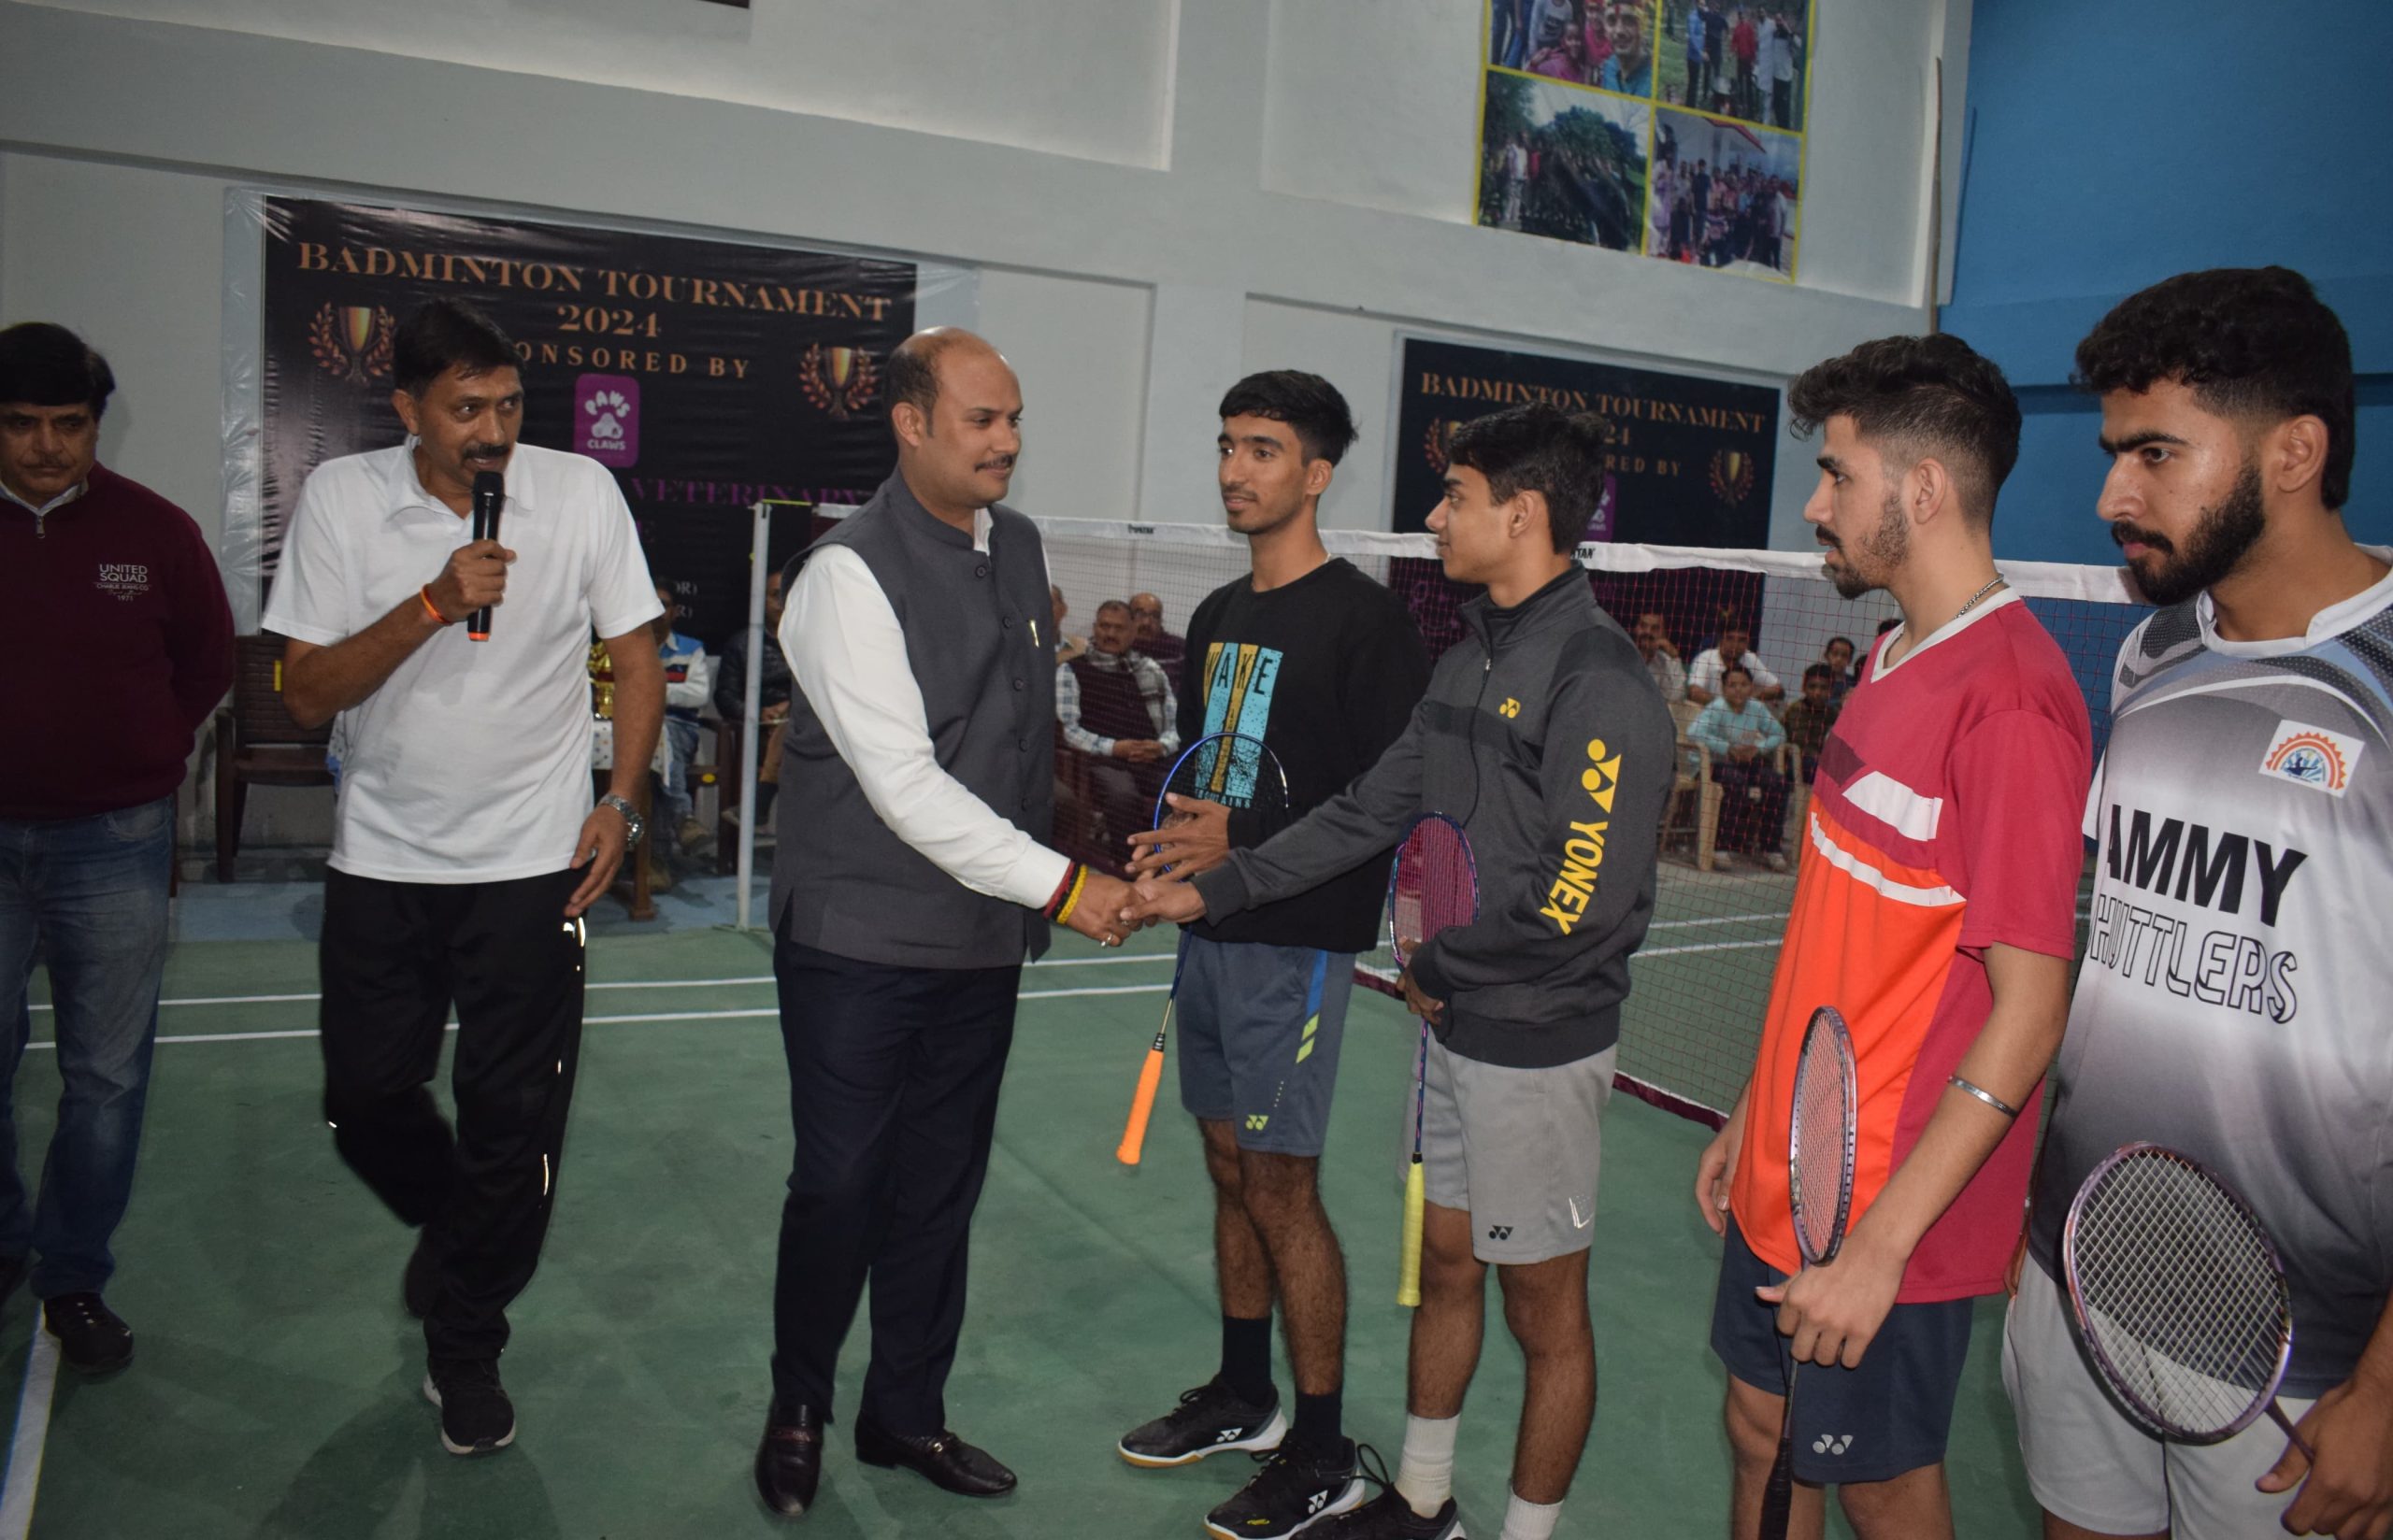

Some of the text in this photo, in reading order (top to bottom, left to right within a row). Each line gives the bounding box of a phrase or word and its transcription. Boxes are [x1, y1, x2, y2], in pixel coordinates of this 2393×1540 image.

[297, 242, 892, 321] BADMINTON TOURNAMENT
[556, 305, 662, 338] 2024
[513, 341, 750, 379] ONSORED BY
[584, 390, 631, 418] PAWS
[1420, 372, 1766, 434] BADMINTON TOURNAMENT
[586, 438, 626, 450] CLAWS
[1603, 423, 1630, 446] 24
[1656, 458, 1682, 478] BY
[99, 563, 148, 575] UNITED
[99, 572, 148, 583] SQUAD
[1205, 651, 1273, 695] WAKE
[1540, 820, 1609, 935] YONEX
[2088, 893, 2298, 1024] HUTTLERS
